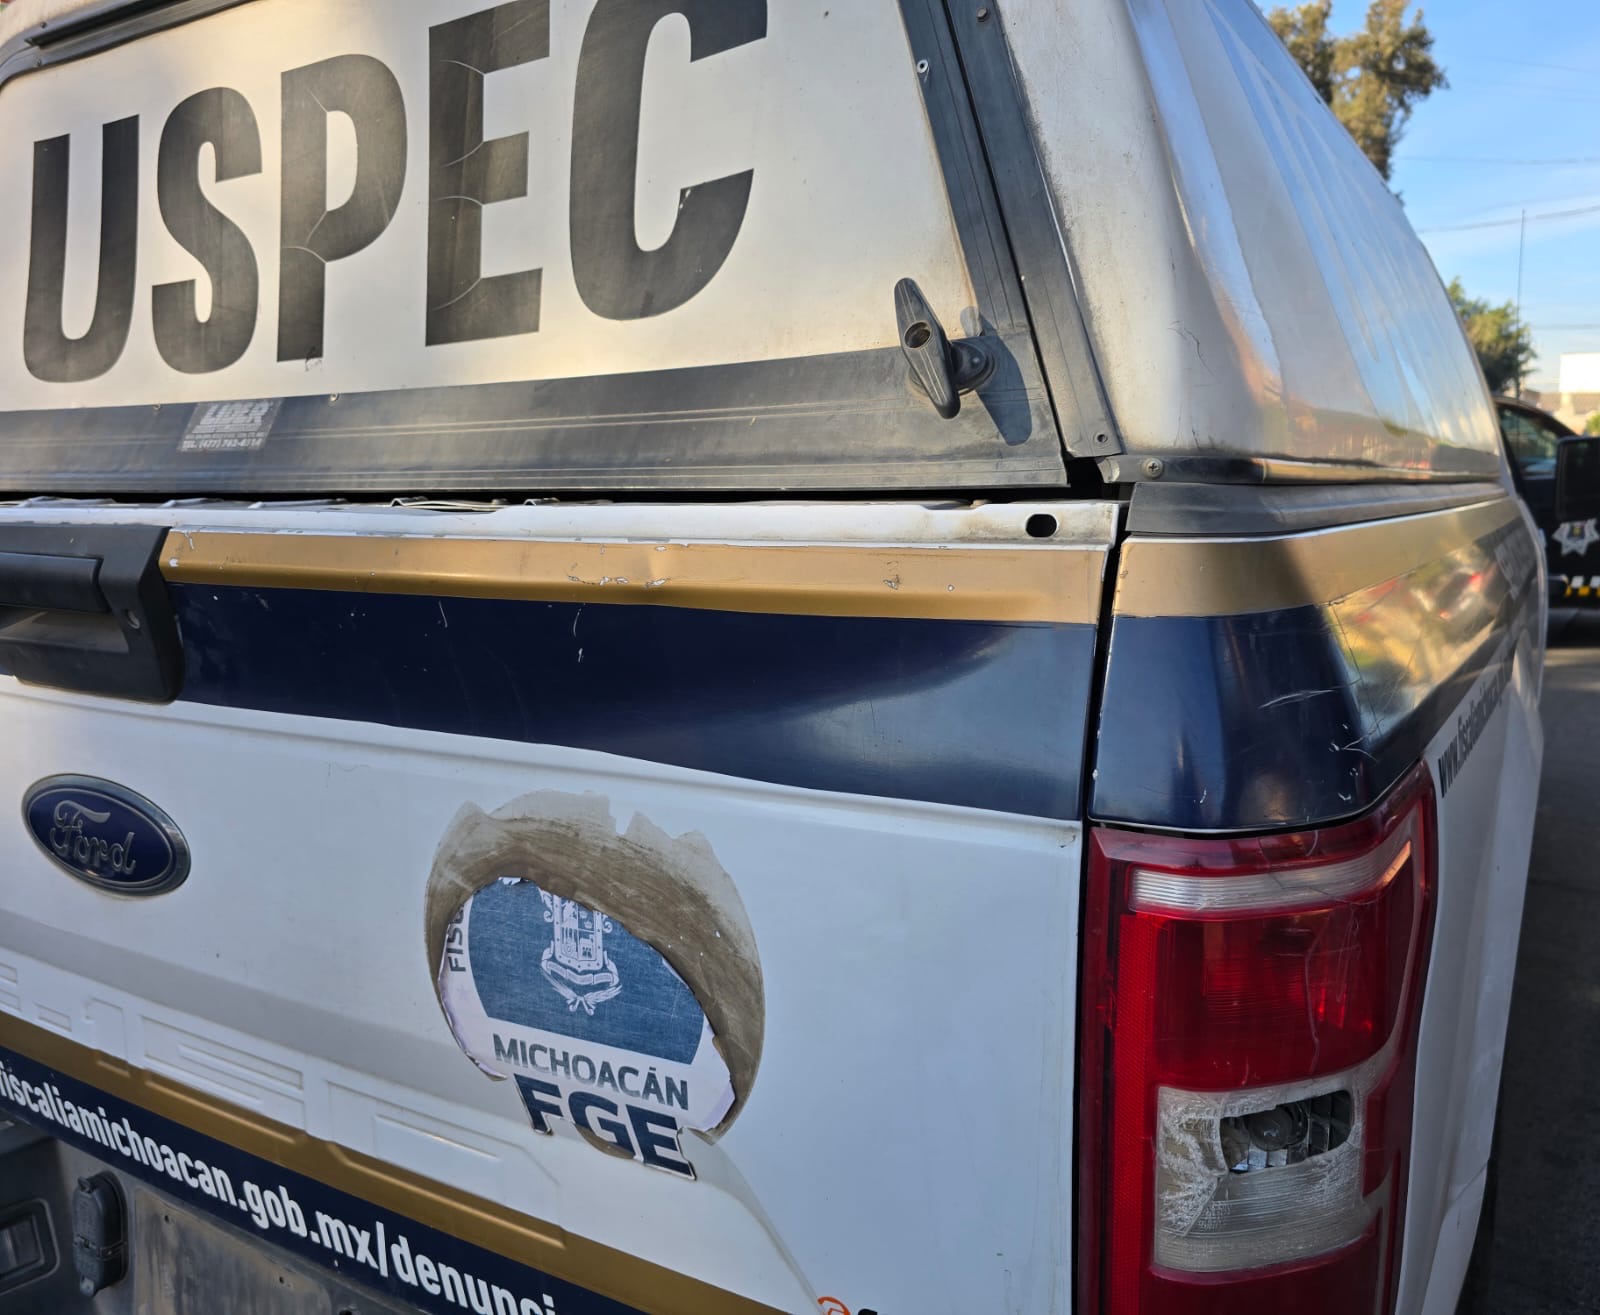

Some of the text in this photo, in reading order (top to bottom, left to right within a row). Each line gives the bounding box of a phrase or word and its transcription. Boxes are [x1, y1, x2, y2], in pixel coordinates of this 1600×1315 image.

[23, 0, 767, 383] USPEC
[50, 800, 137, 874] Ford
[493, 1034, 689, 1111] MICHOACÁN
[514, 1073, 692, 1178] FGE
